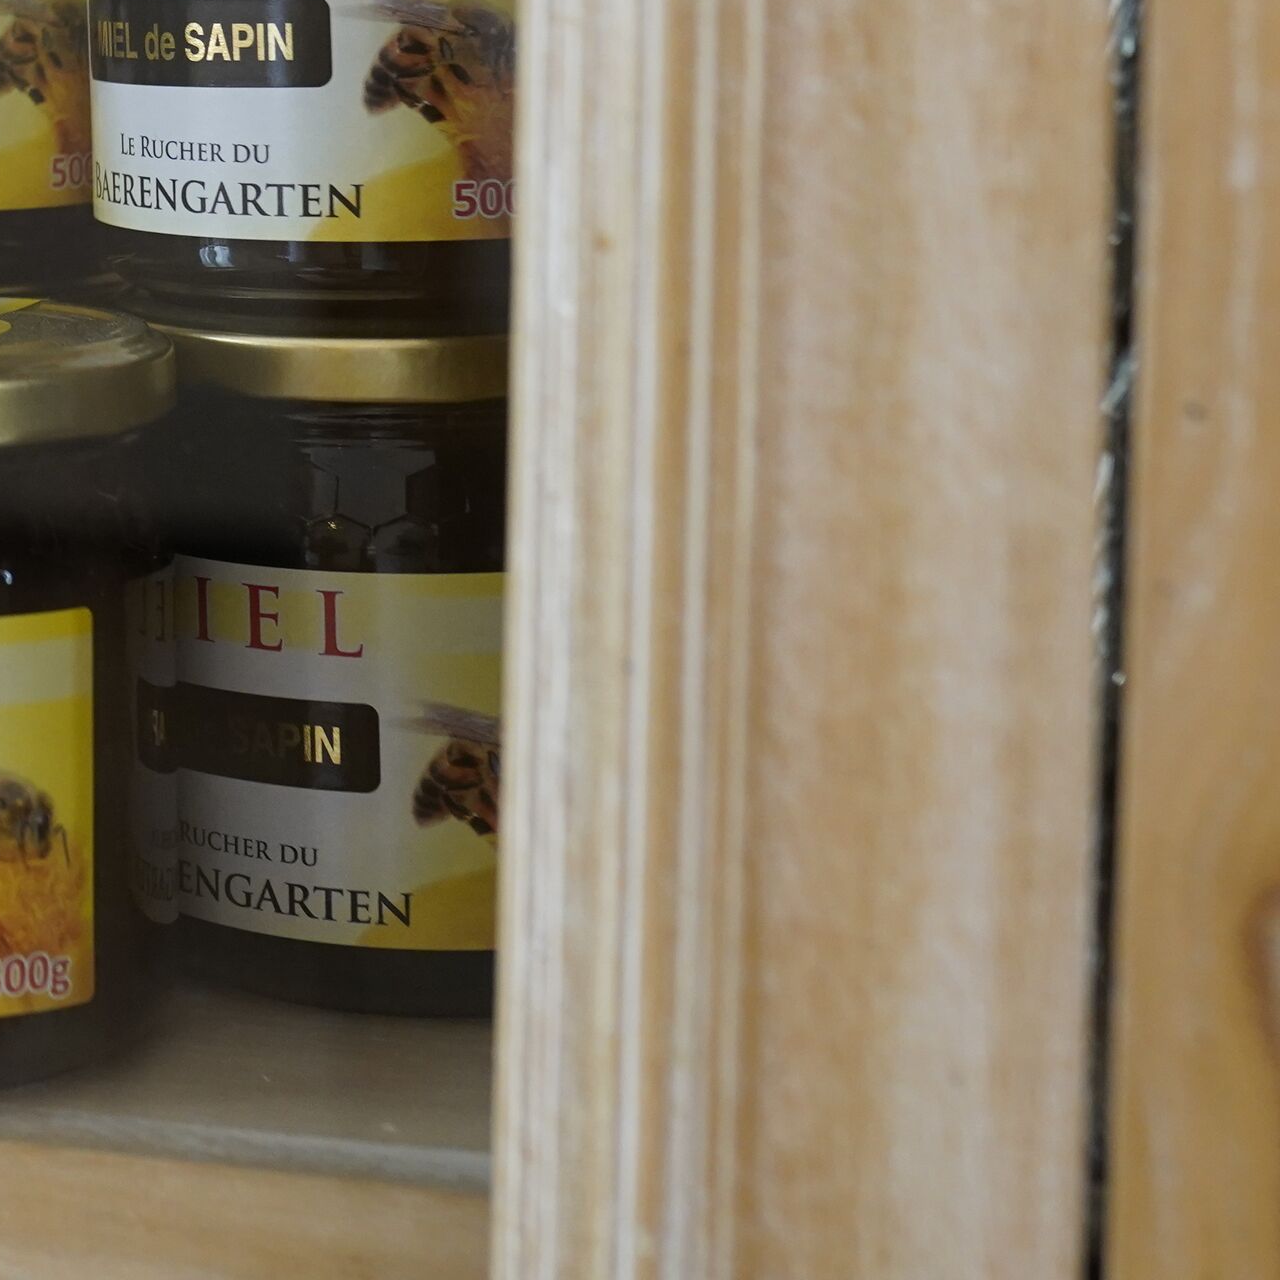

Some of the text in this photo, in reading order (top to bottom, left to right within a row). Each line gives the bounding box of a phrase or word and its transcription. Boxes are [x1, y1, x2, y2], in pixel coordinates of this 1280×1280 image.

[96, 21, 295, 62] MIEL de SAPIN
[120, 132, 271, 164] LE RUCHER DU
[49, 154, 91, 189] 50
[95, 161, 364, 219] BAERENGARTEN
[453, 179, 514, 219] 50
[195, 576, 364, 658] IEL
[178, 821, 319, 868] RUCHER DU
[178, 859, 413, 928] ENGARTEN
